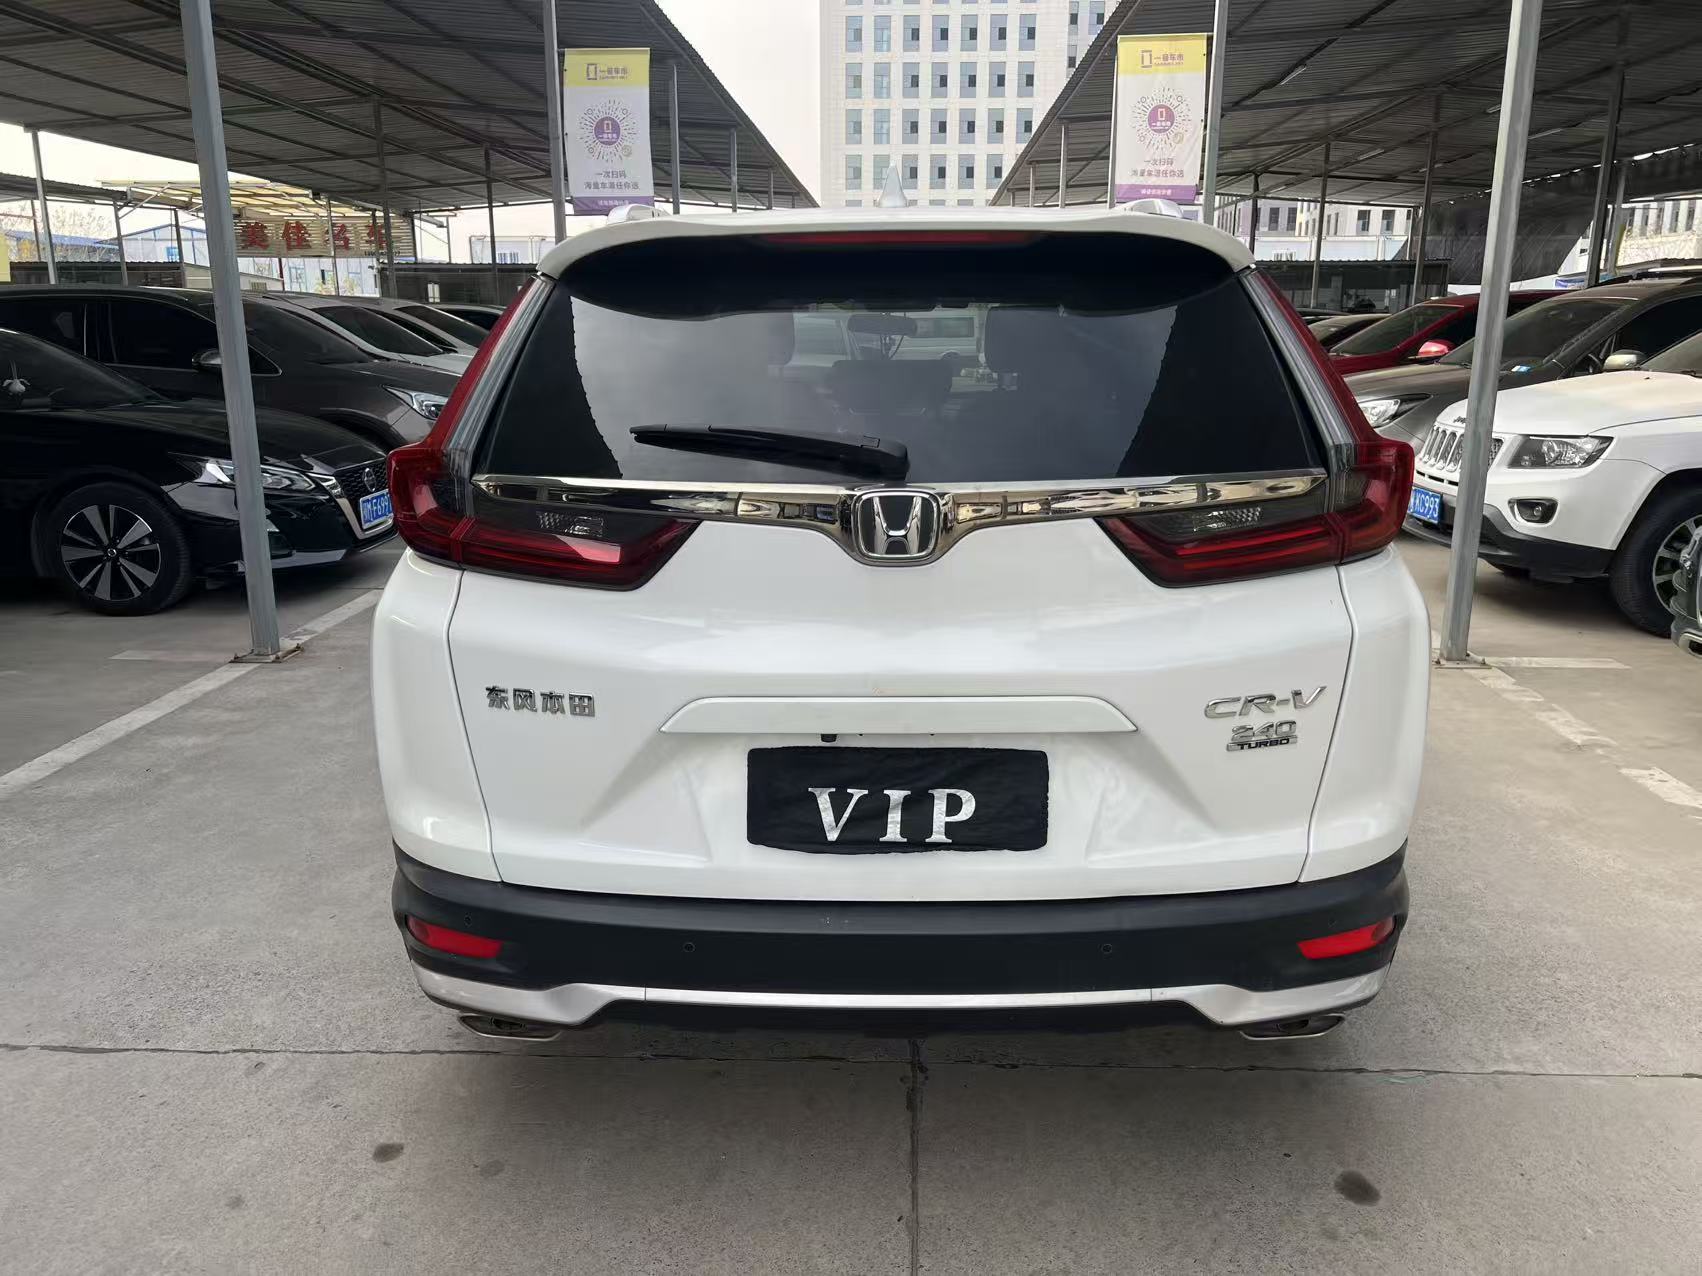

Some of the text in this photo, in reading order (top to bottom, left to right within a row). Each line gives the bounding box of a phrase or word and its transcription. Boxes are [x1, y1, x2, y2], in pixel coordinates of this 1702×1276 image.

[485, 686, 596, 717] 东风本田
[1204, 685, 1327, 718] CR-V
[1231, 720, 1297, 741] 240
[1237, 738, 1290, 750] TURBO
[808, 787, 977, 843] VIP
